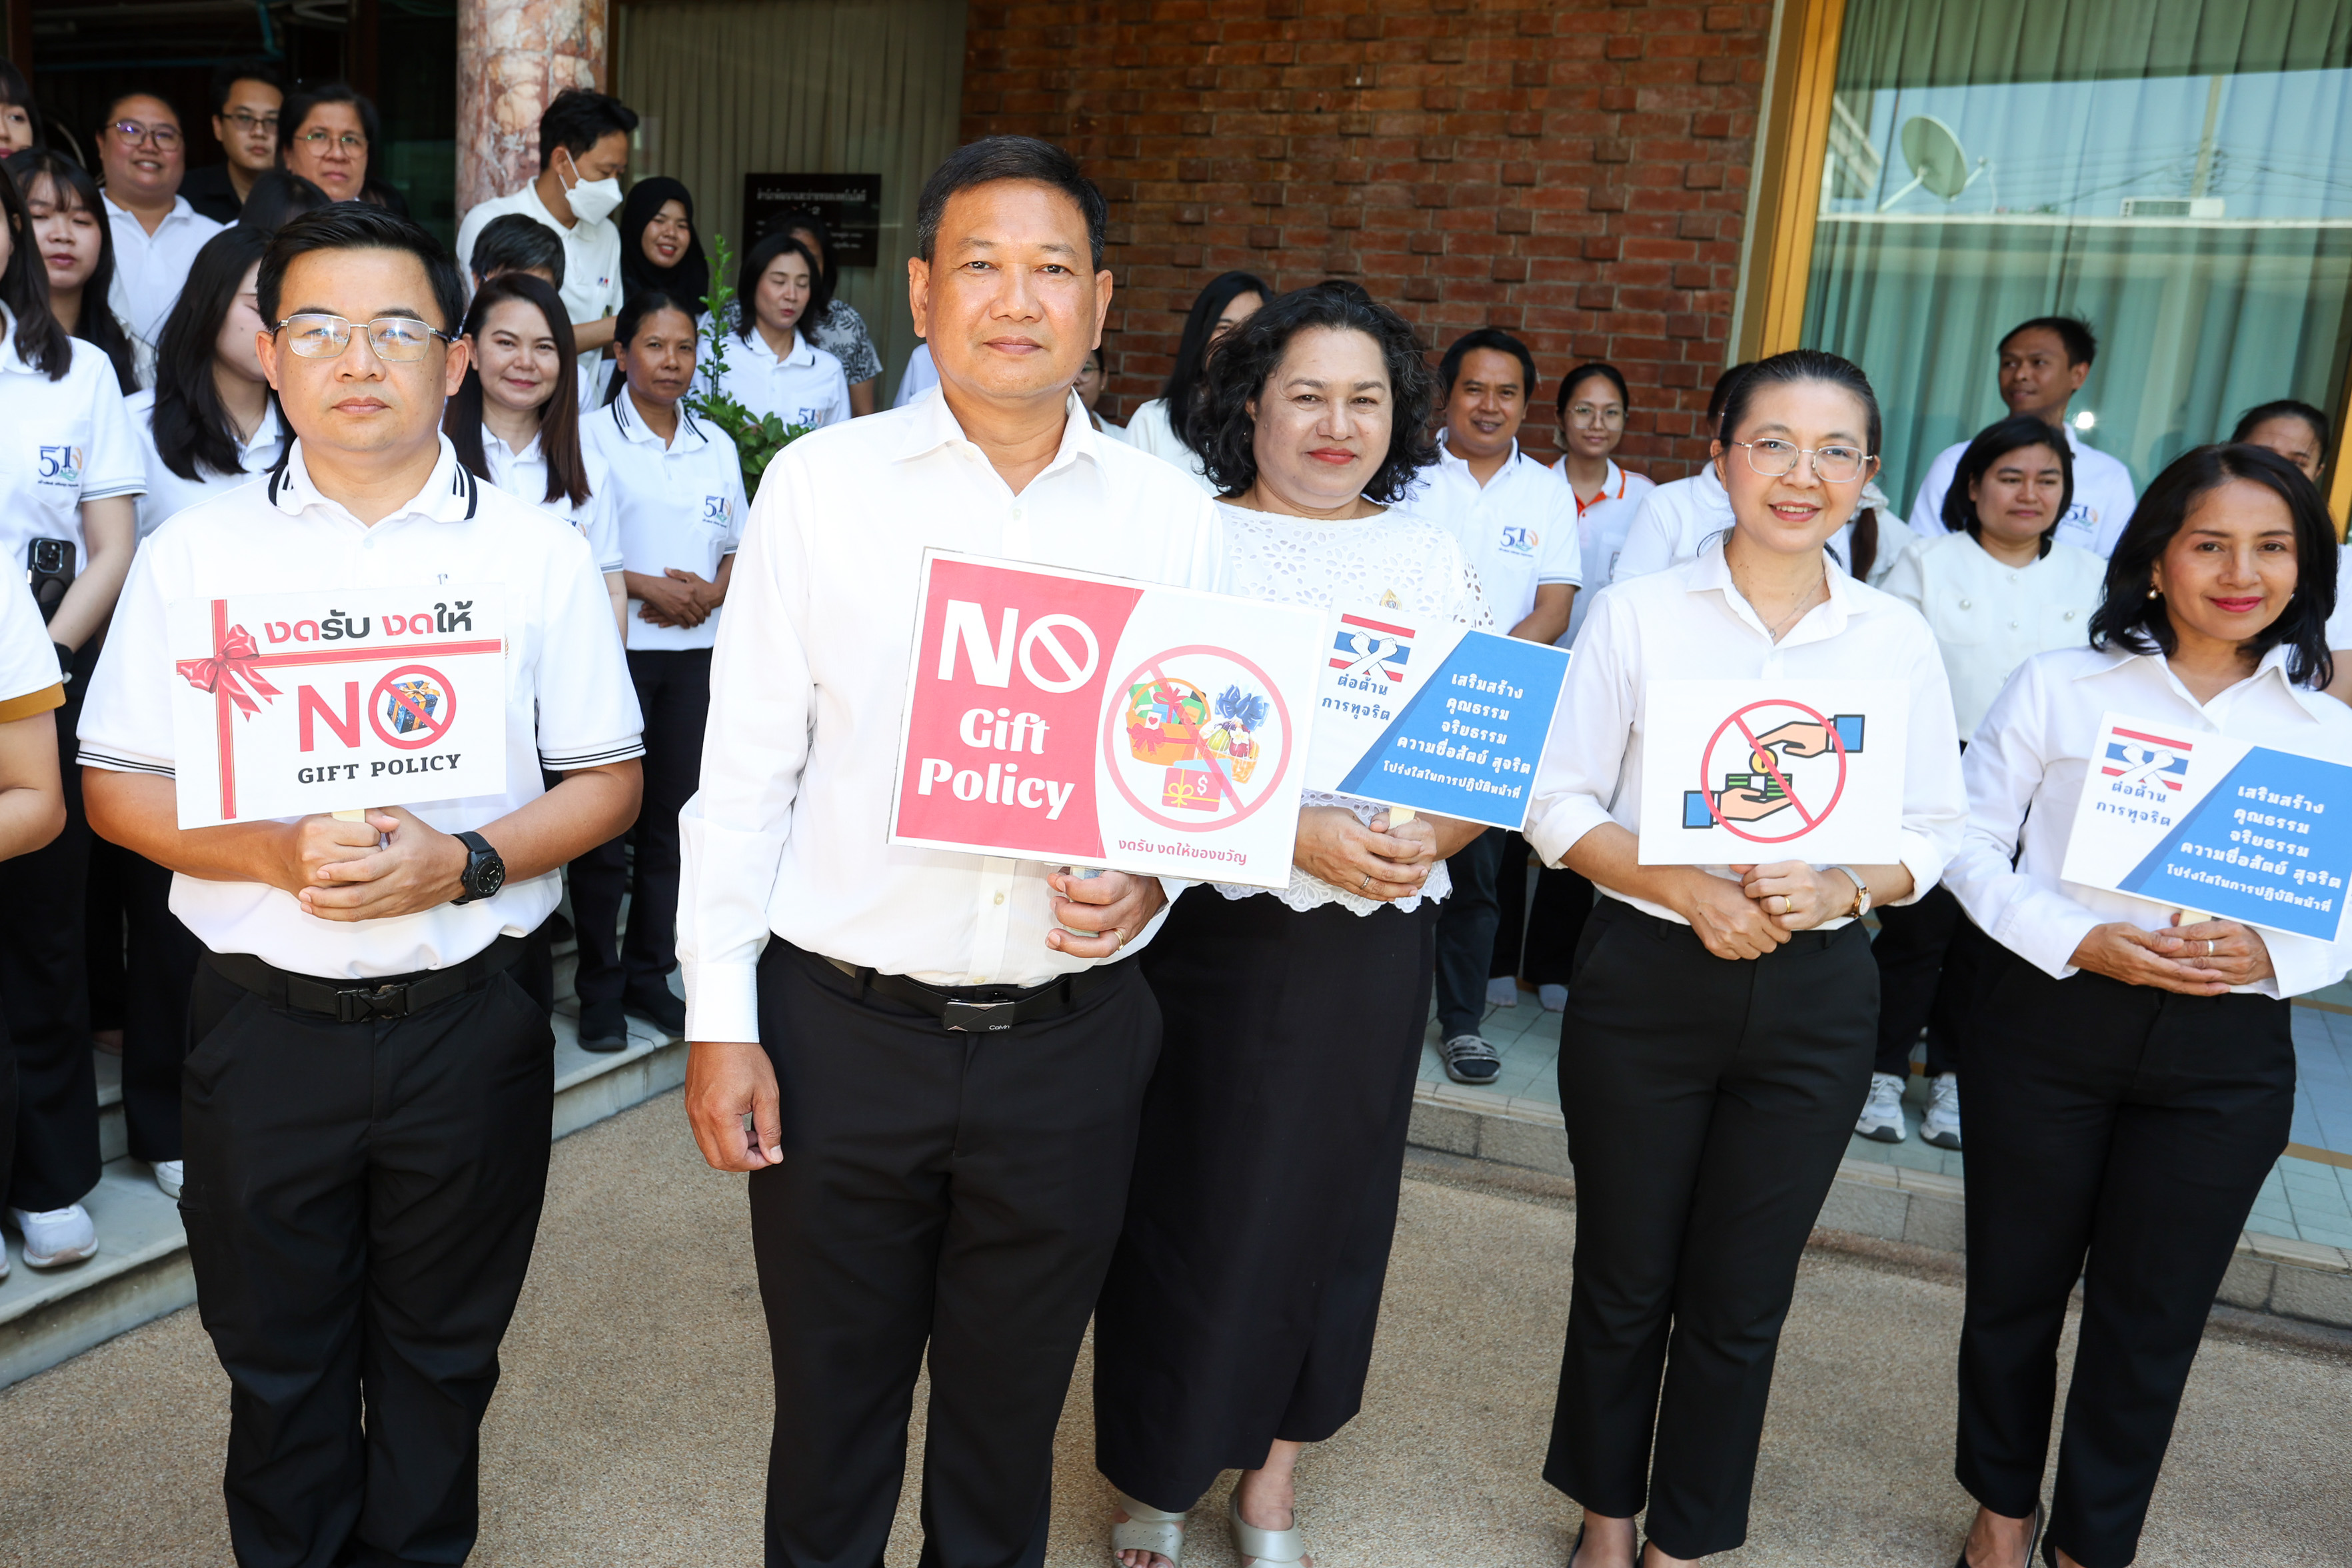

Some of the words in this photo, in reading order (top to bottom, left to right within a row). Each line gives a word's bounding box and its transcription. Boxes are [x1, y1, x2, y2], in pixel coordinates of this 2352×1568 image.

[39, 445, 71, 477] 51
[703, 495, 725, 518] 51
[1500, 525, 1526, 547] 51
[264, 609, 371, 643] งดรับ
[381, 600, 473, 636] งดให้
[1338, 674, 1388, 695] ต่อต้าน
[1451, 672, 1524, 700] เสริมสร้าง
[1322, 696, 1390, 721] การทุจริต
[1446, 697, 1510, 721] คุณธรรม
[958, 707, 1050, 755] Gift
[1441, 720, 1508, 744] จริยธรรม
[297, 764, 360, 784] GIFT
[371, 754, 461, 778] POLICY
[1396, 736, 1488, 765] ความซื่อสัตย์
[1492, 756, 1532, 774] สุจริต
[917, 757, 1076, 821] Policy
[2111, 780, 2167, 803] ต่อต้าน
[2237, 785, 2325, 814] เสริมสร้าง
[2096, 800, 2171, 826] การทุจริต
[2233, 808, 2310, 834] คุณธรรม
[1118, 838, 1154, 852] งดรับ
[1157, 842, 1247, 866] งดให้ของขวัญ
[2229, 828, 2310, 858] จริยธรรม
[2180, 841, 2287, 876] ความซื่อสัตย์
[2293, 868, 2342, 889] สุจริต
